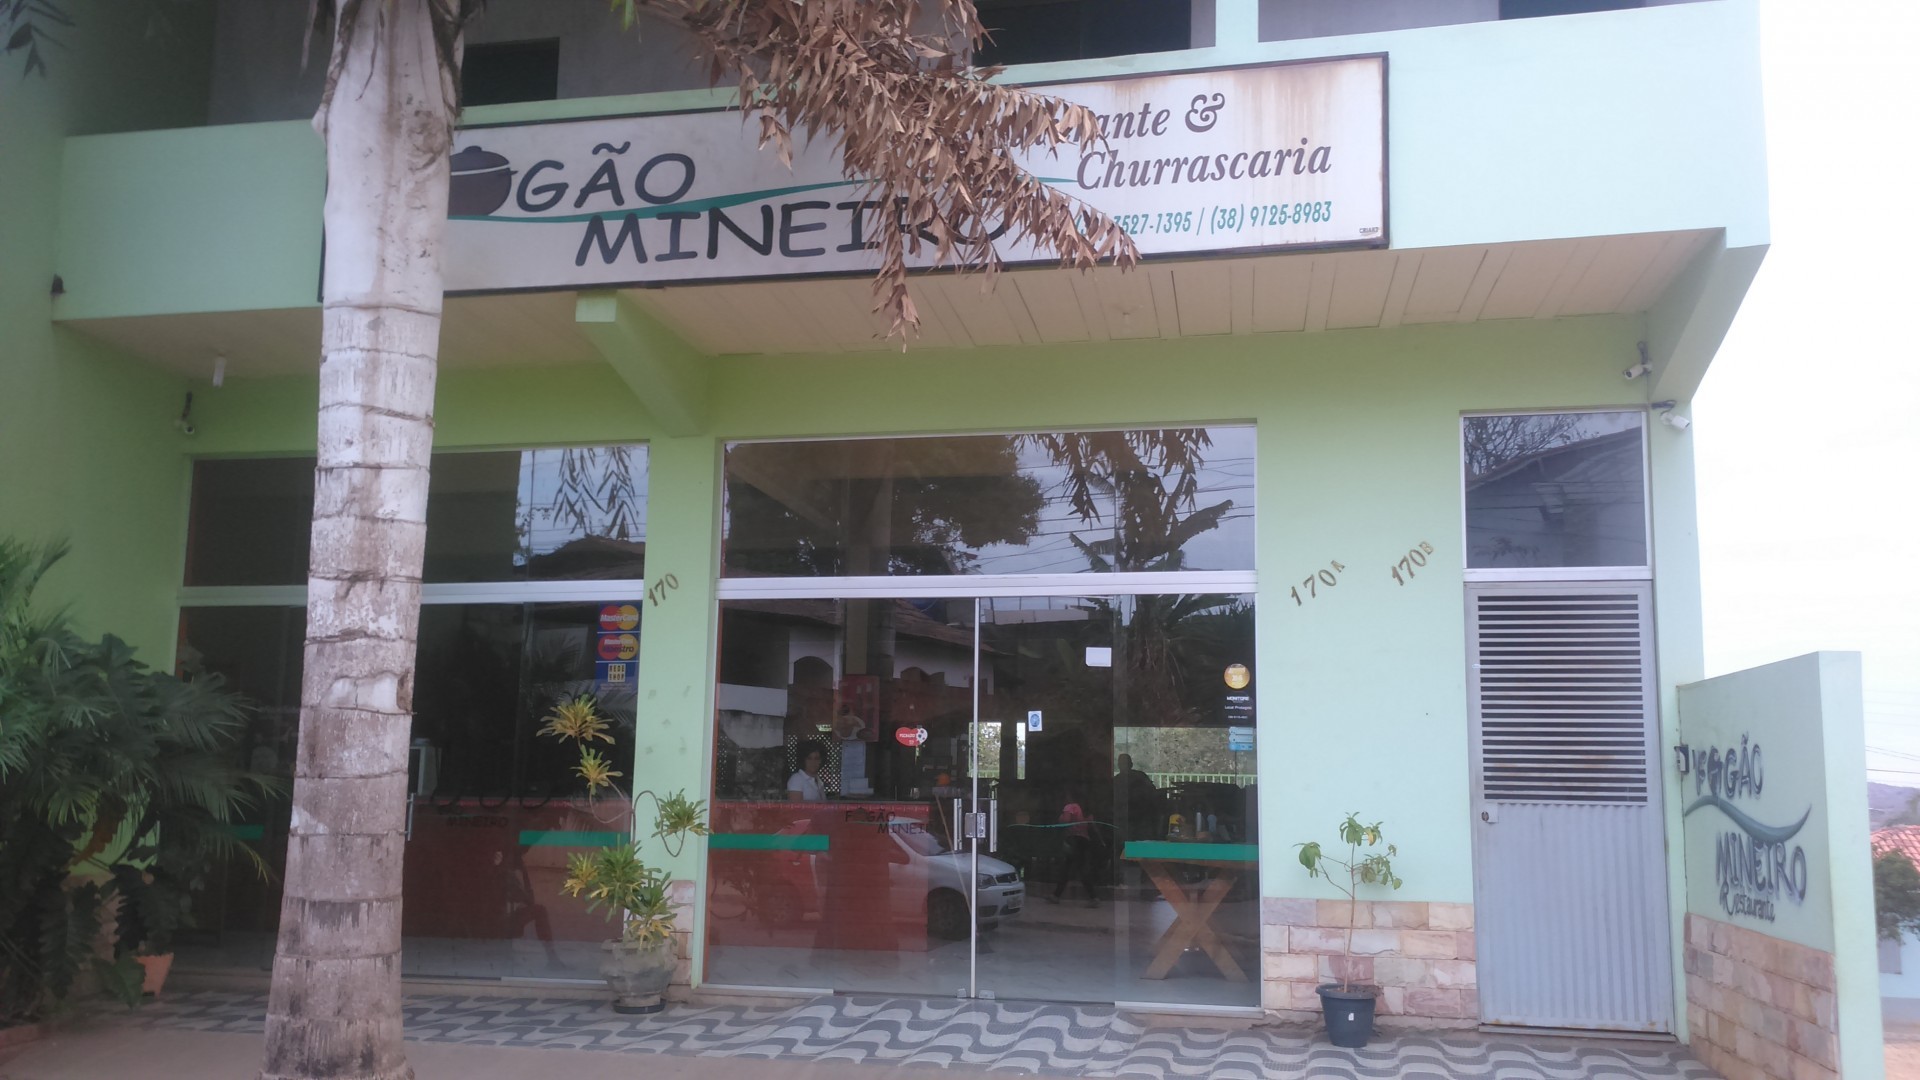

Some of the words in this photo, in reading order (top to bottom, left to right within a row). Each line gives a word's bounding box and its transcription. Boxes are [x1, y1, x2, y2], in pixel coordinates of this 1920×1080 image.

[1184, 93, 1225, 133] &
[1076, 138, 1332, 191] Churrascaria
[1210, 204, 1245, 235] (38)
[1250, 200, 1332, 228] 9125-8983
[648, 572, 679, 607] 170
[1715, 831, 1807, 905] MINEIRO
